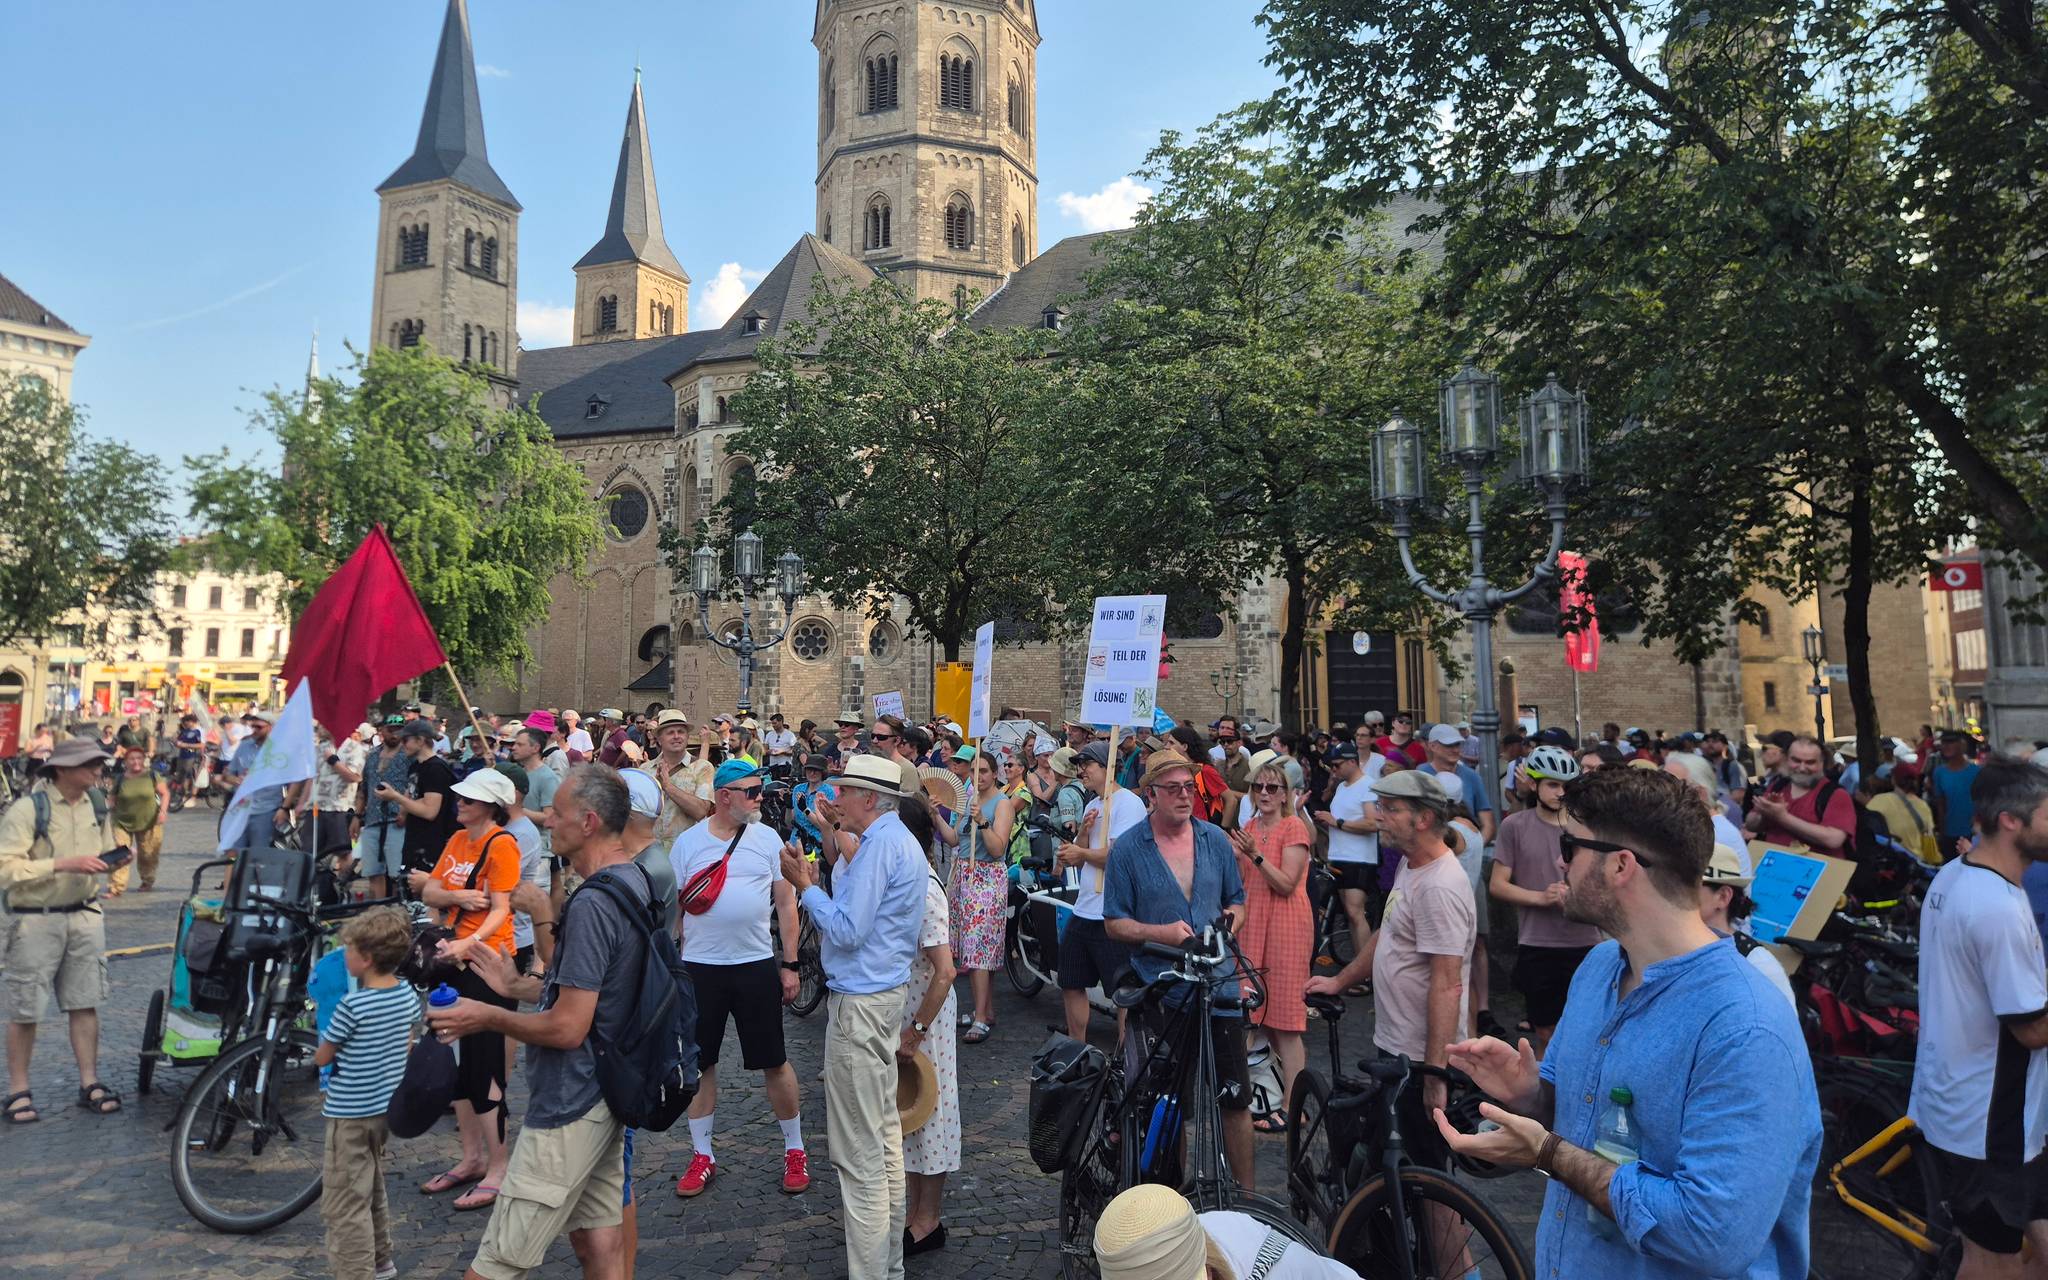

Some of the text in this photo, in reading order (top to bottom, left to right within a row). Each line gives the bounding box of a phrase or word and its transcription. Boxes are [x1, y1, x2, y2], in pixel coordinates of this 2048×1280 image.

[1100, 610, 1135, 621] WIR SIND
[1113, 650, 1146, 661] TEIL DER
[1094, 689, 1127, 703] LÖSUNG!
